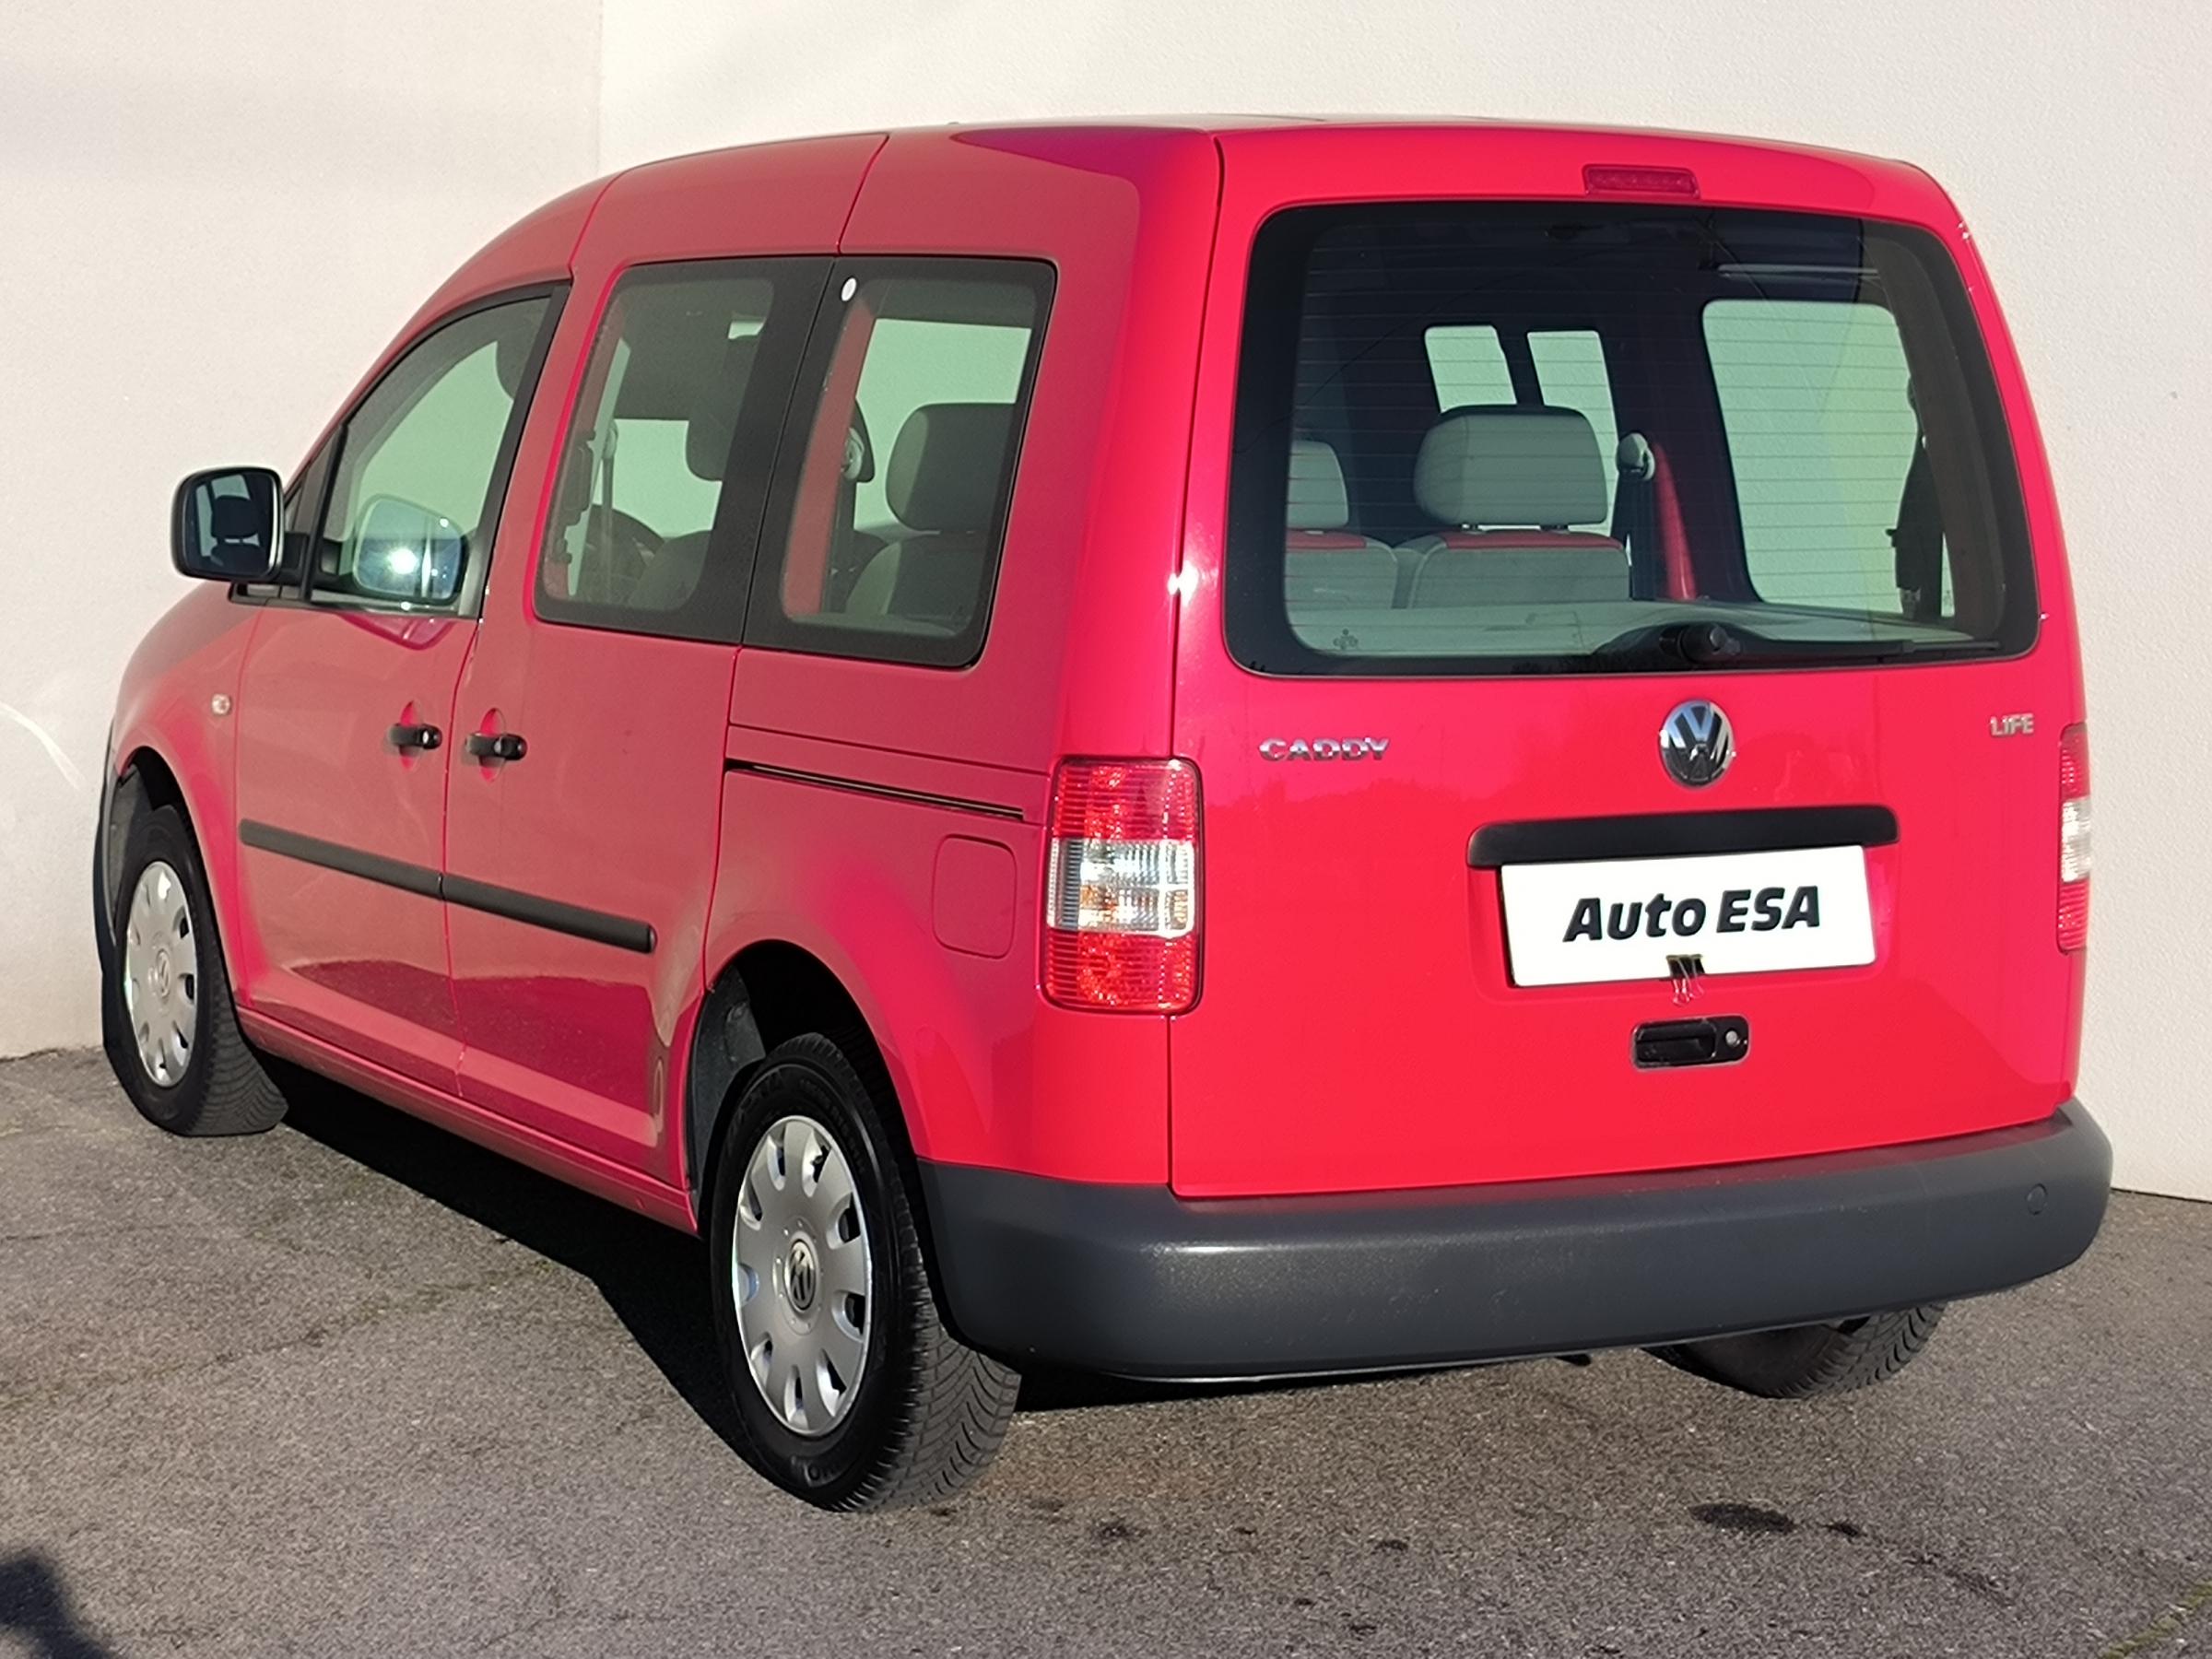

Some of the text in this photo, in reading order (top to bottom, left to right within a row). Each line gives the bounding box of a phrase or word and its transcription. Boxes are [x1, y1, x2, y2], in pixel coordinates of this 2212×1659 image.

[1990, 712, 2034, 736] LIFE
[1259, 737, 1389, 761] CADDY
[1562, 885, 1819, 942] Auto ESA
